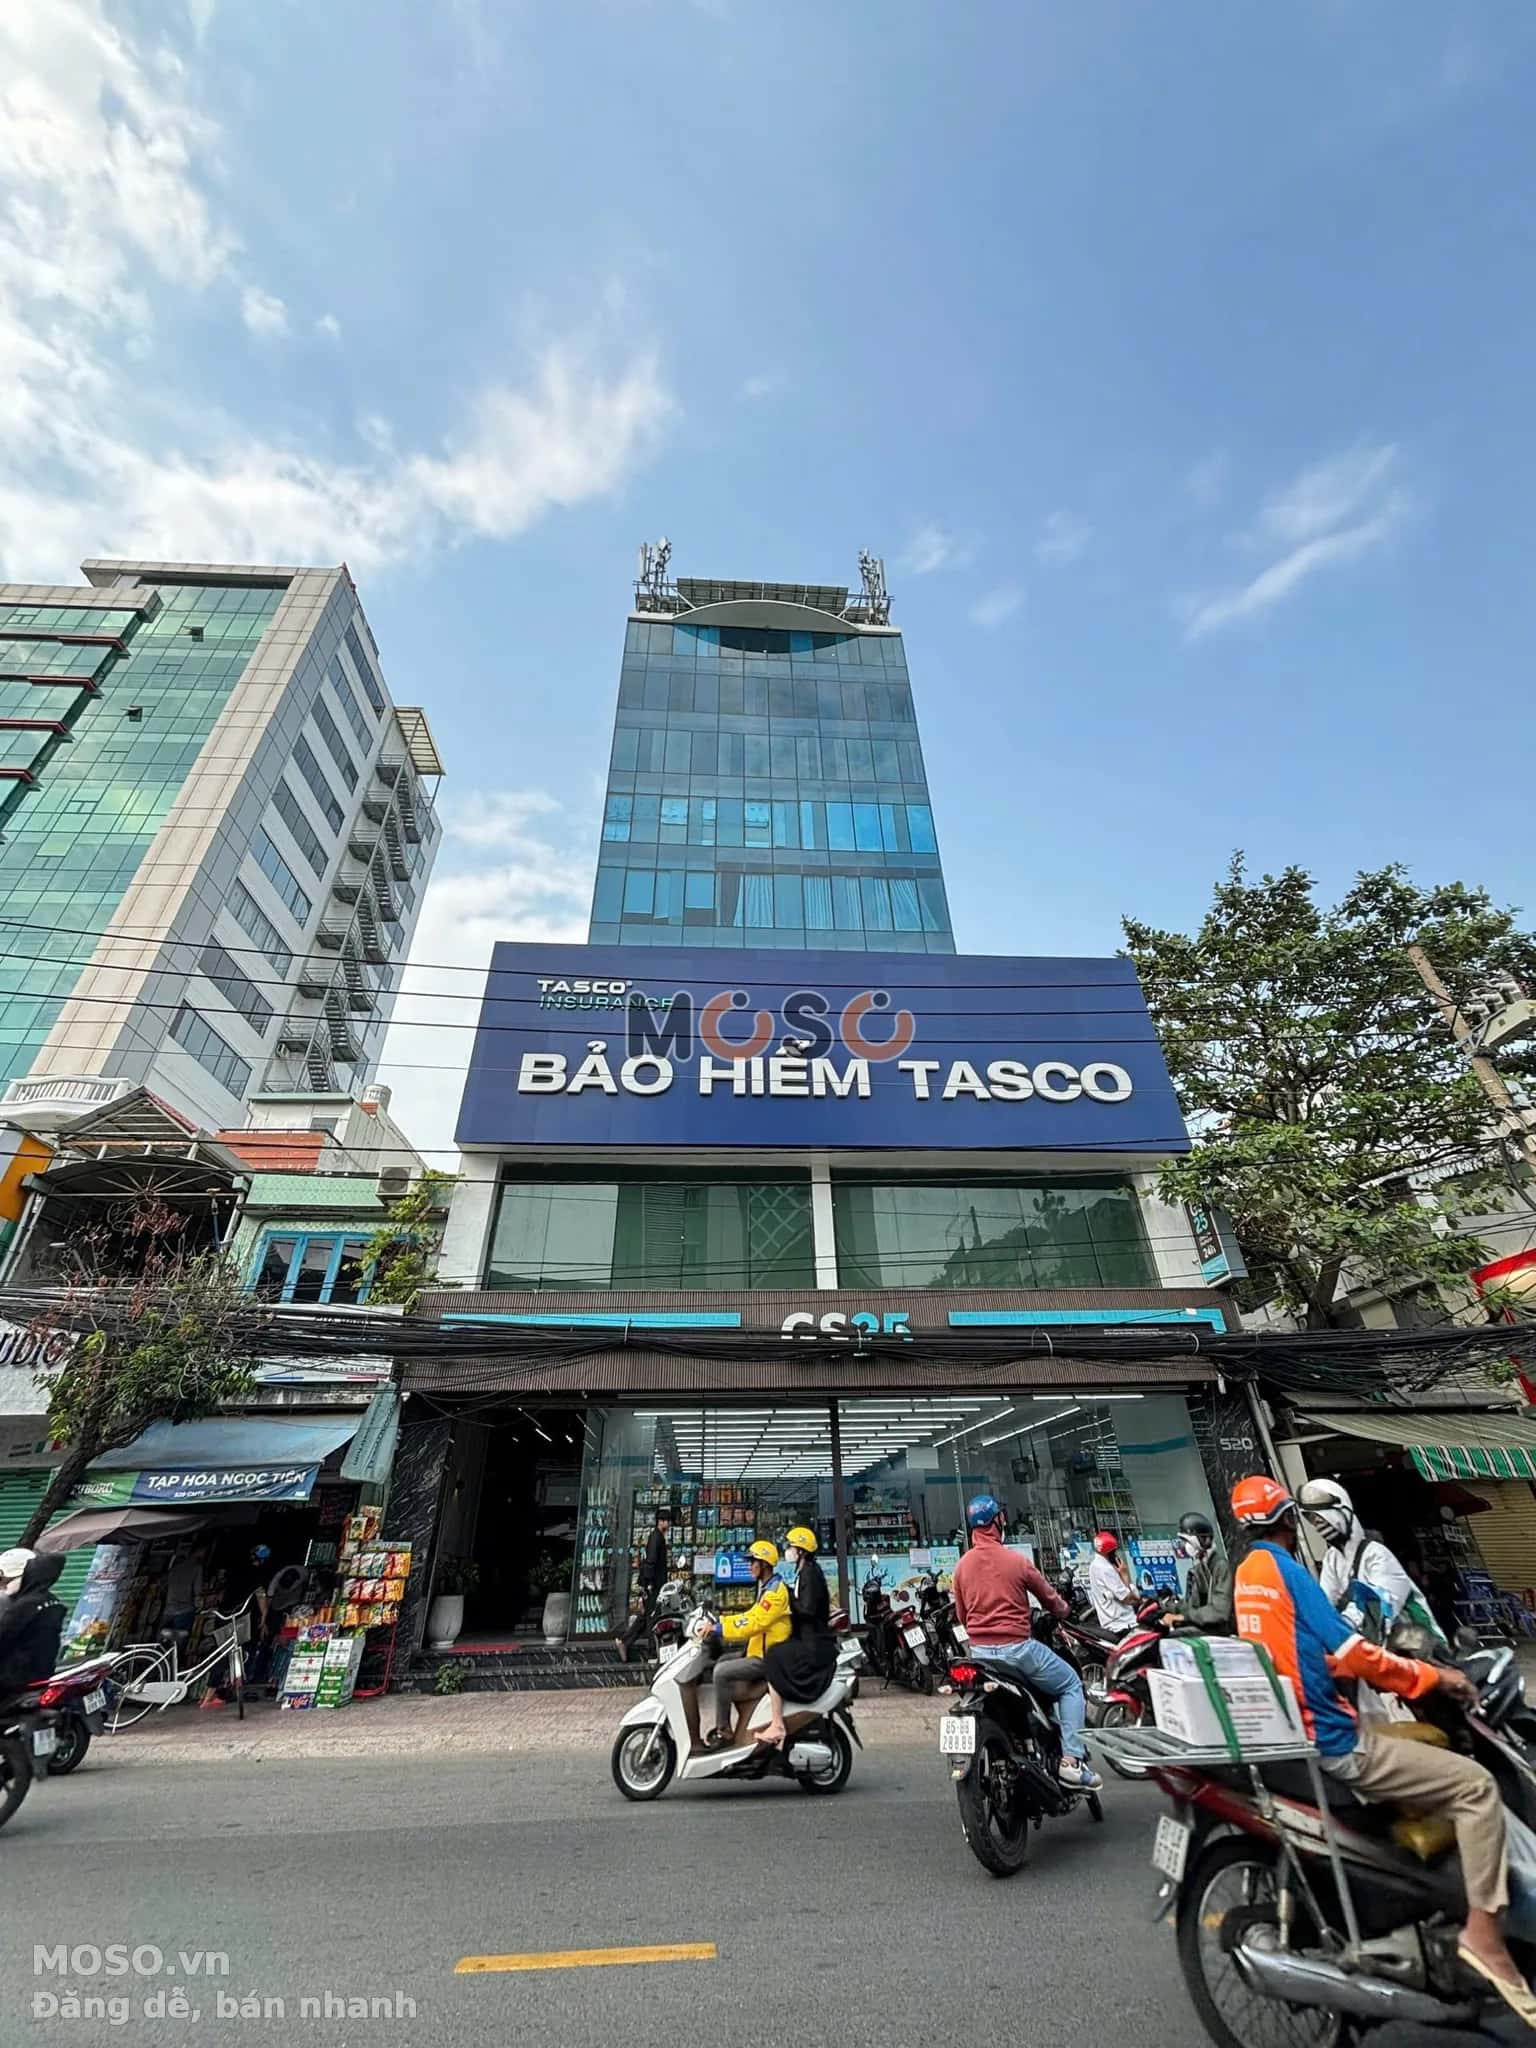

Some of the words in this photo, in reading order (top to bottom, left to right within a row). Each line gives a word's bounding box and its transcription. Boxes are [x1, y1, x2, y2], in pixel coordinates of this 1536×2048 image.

[537, 980, 627, 994] TASCO
[517, 1041, 673, 1096] BẢO
[699, 1040, 871, 1098] HIỂM
[898, 1060, 1134, 1104] TASCO
[1220, 1437, 1254, 1451] 520
[148, 1475, 181, 1491] TẠP
[181, 1471, 217, 1487] HÓA
[220, 1472, 268, 1488] NGỌC
